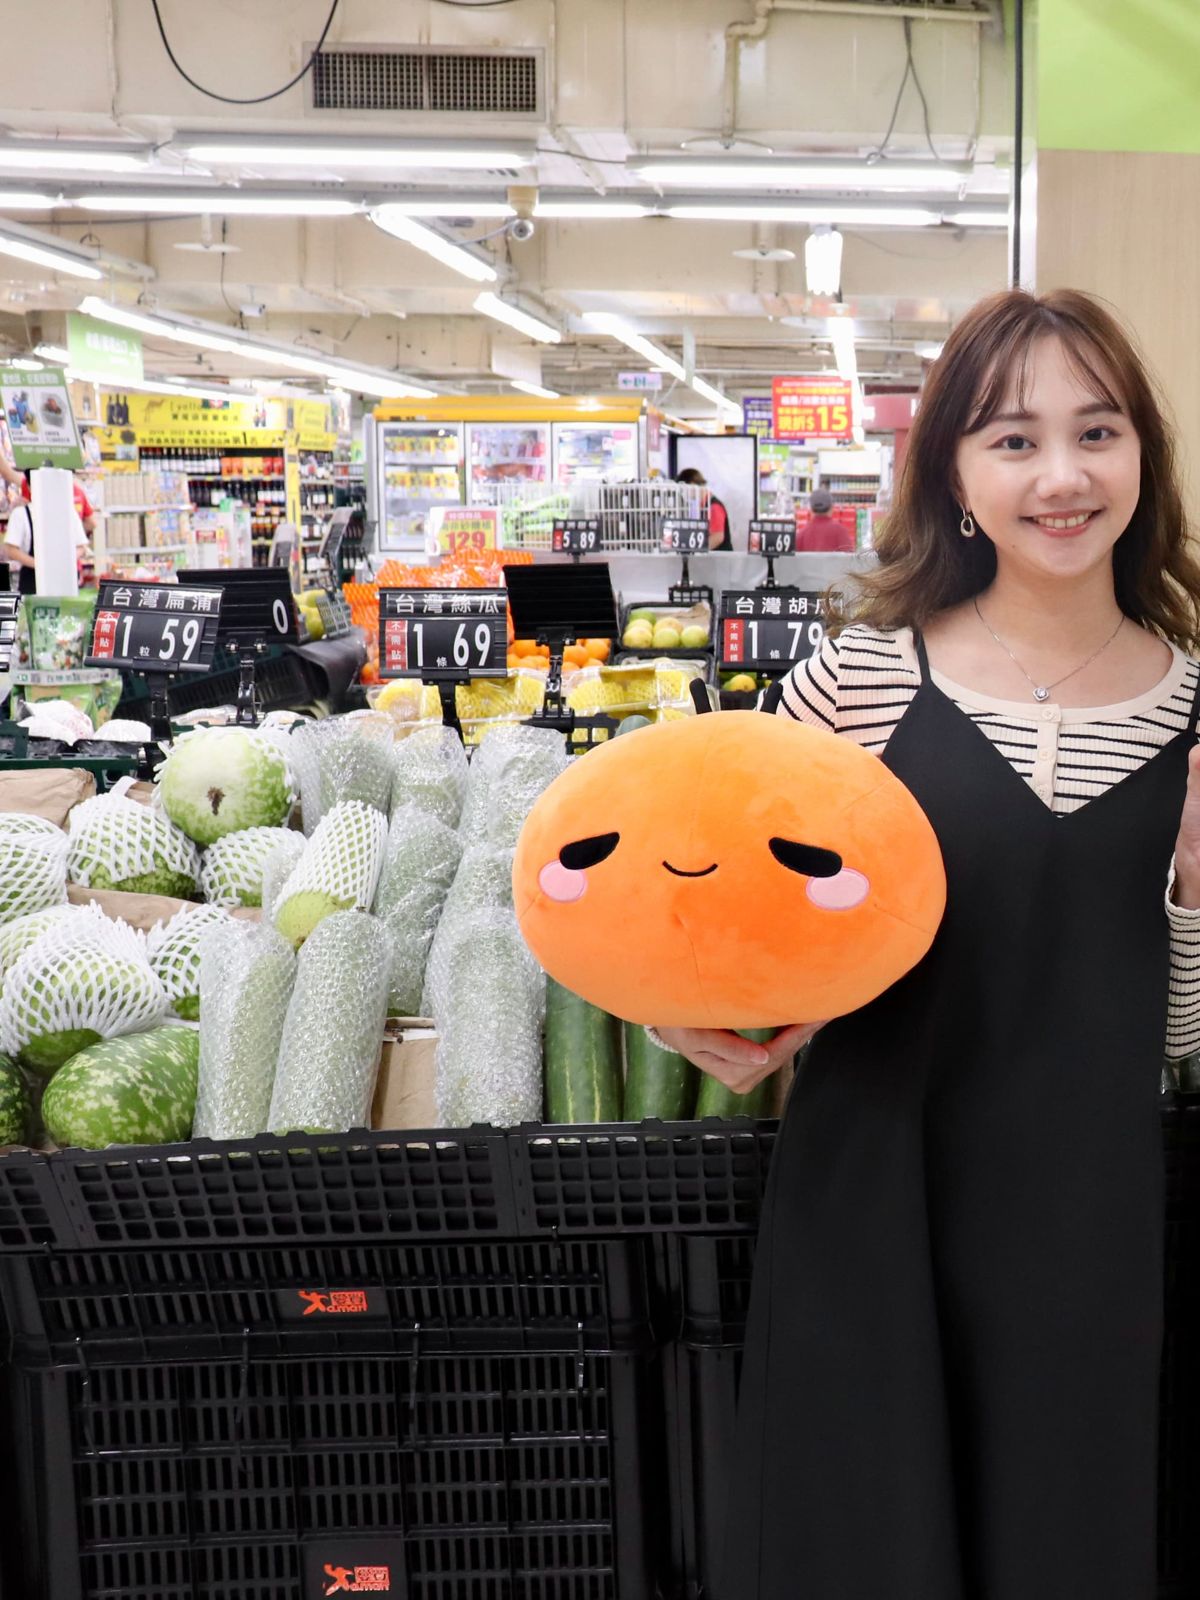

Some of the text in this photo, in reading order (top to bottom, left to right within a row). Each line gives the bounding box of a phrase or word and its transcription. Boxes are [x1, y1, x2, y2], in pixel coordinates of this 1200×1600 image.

[817, 405, 849, 432] 15
[580, 531, 596, 549] 89
[688, 531, 705, 549] 69
[775, 533, 792, 551] 69
[396, 594, 500, 614] 台灣絲瓜
[122, 615, 200, 661] 1 粒 59
[413, 623, 424, 667] 1
[453, 623, 491, 667] 69
[748, 621, 758, 659] 1
[787, 621, 824, 660] 79
